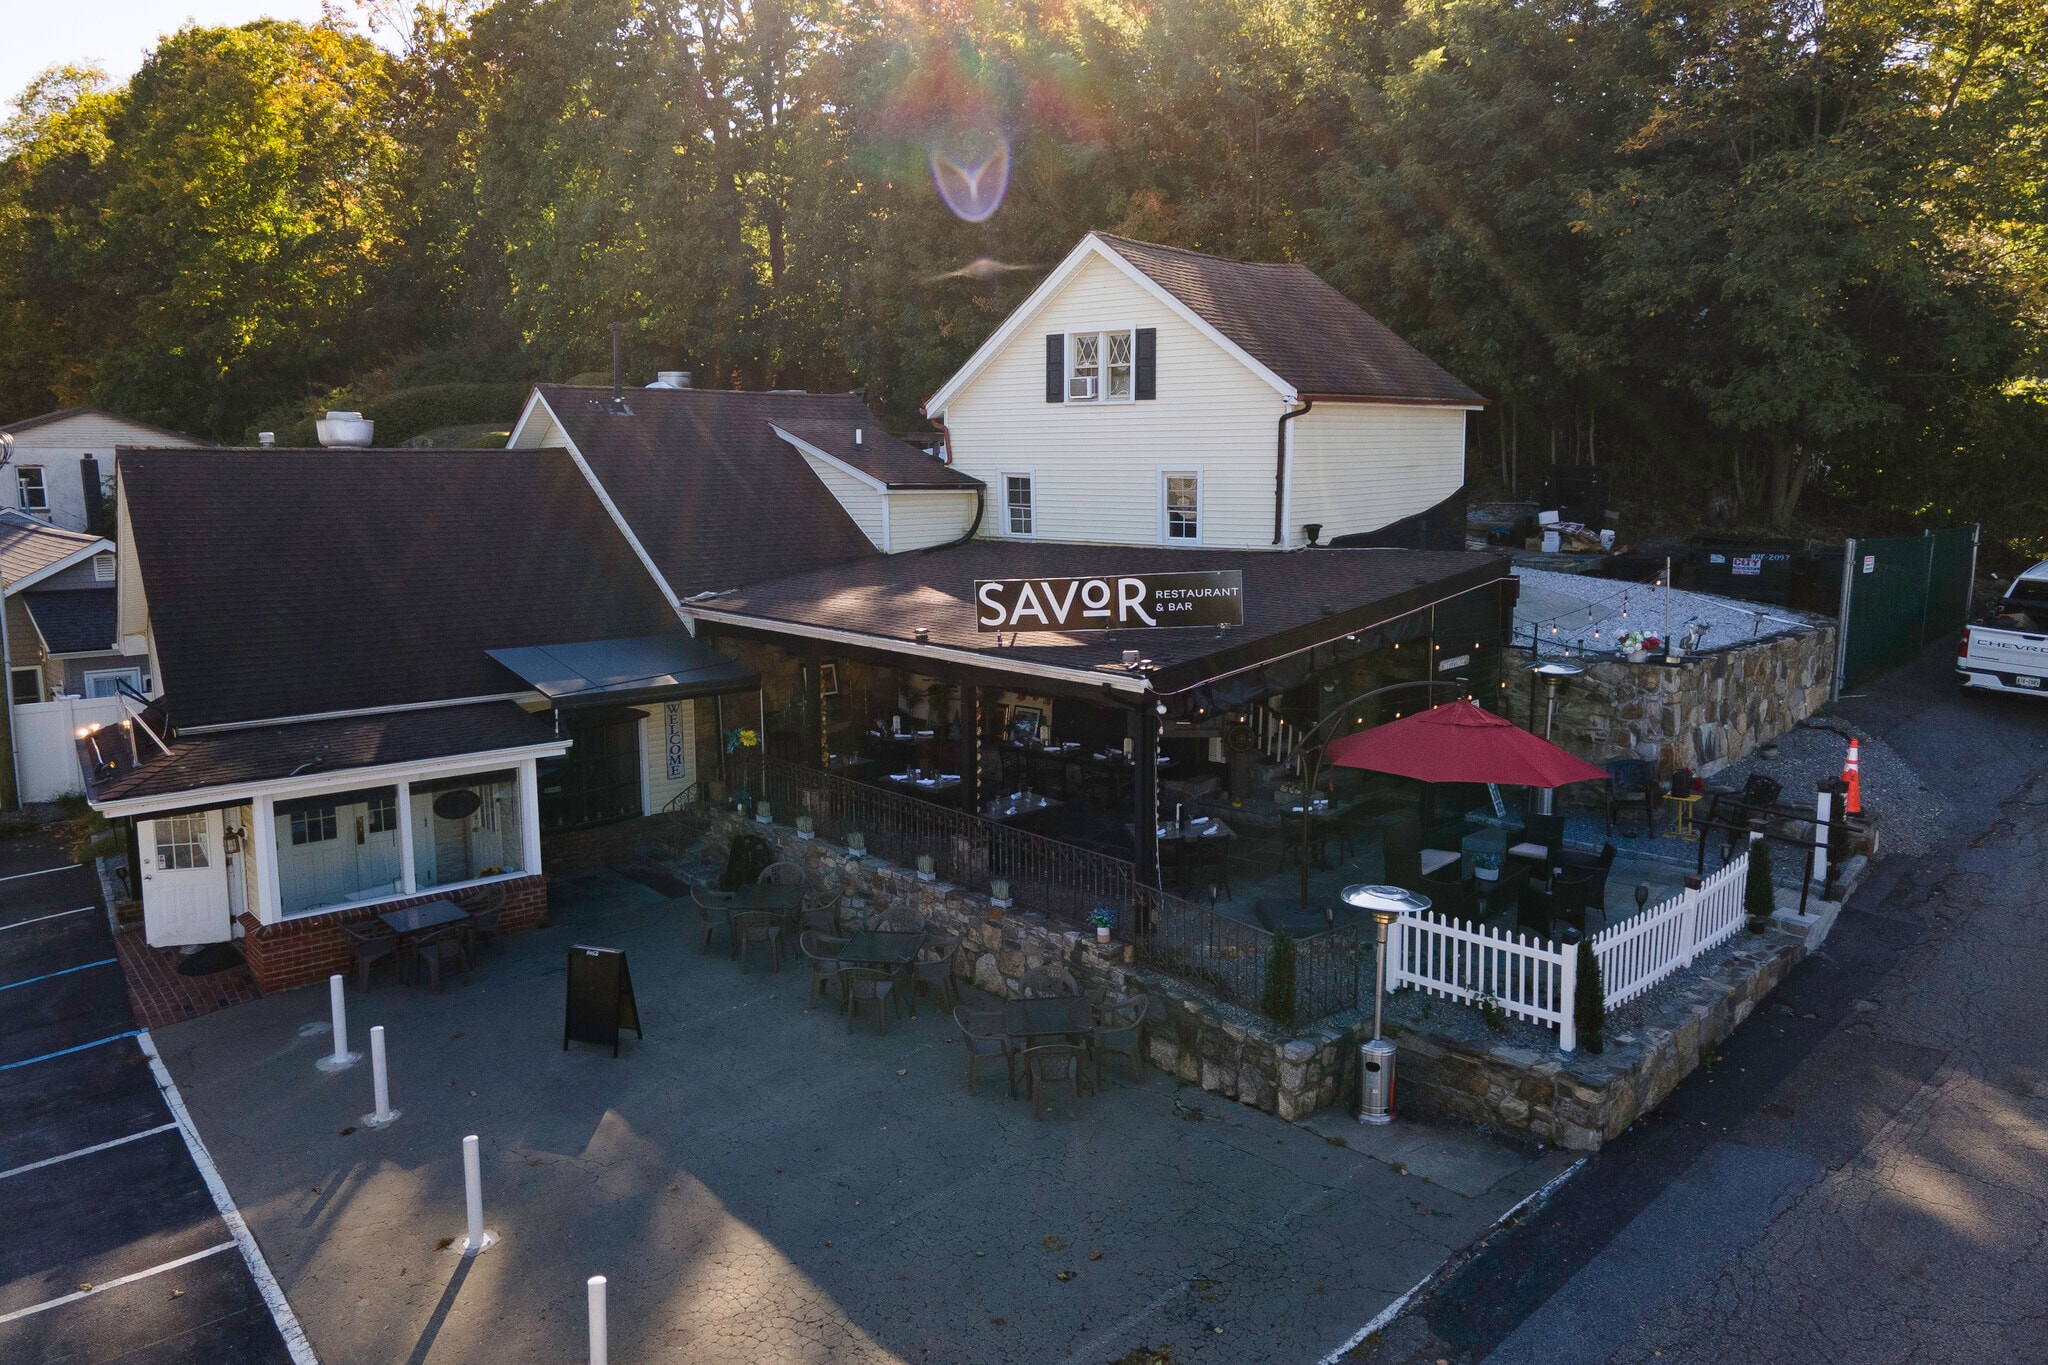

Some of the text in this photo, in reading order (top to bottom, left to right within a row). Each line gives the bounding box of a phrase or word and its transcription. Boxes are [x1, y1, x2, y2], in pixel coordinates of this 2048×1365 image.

[1734, 558, 1760, 567] CITY
[1155, 587, 1240, 600] RESTAURANT
[978, 578, 1157, 627] SAVOR
[1155, 602, 1193, 612] & BAR
[666, 704, 682, 776] WELCOME
